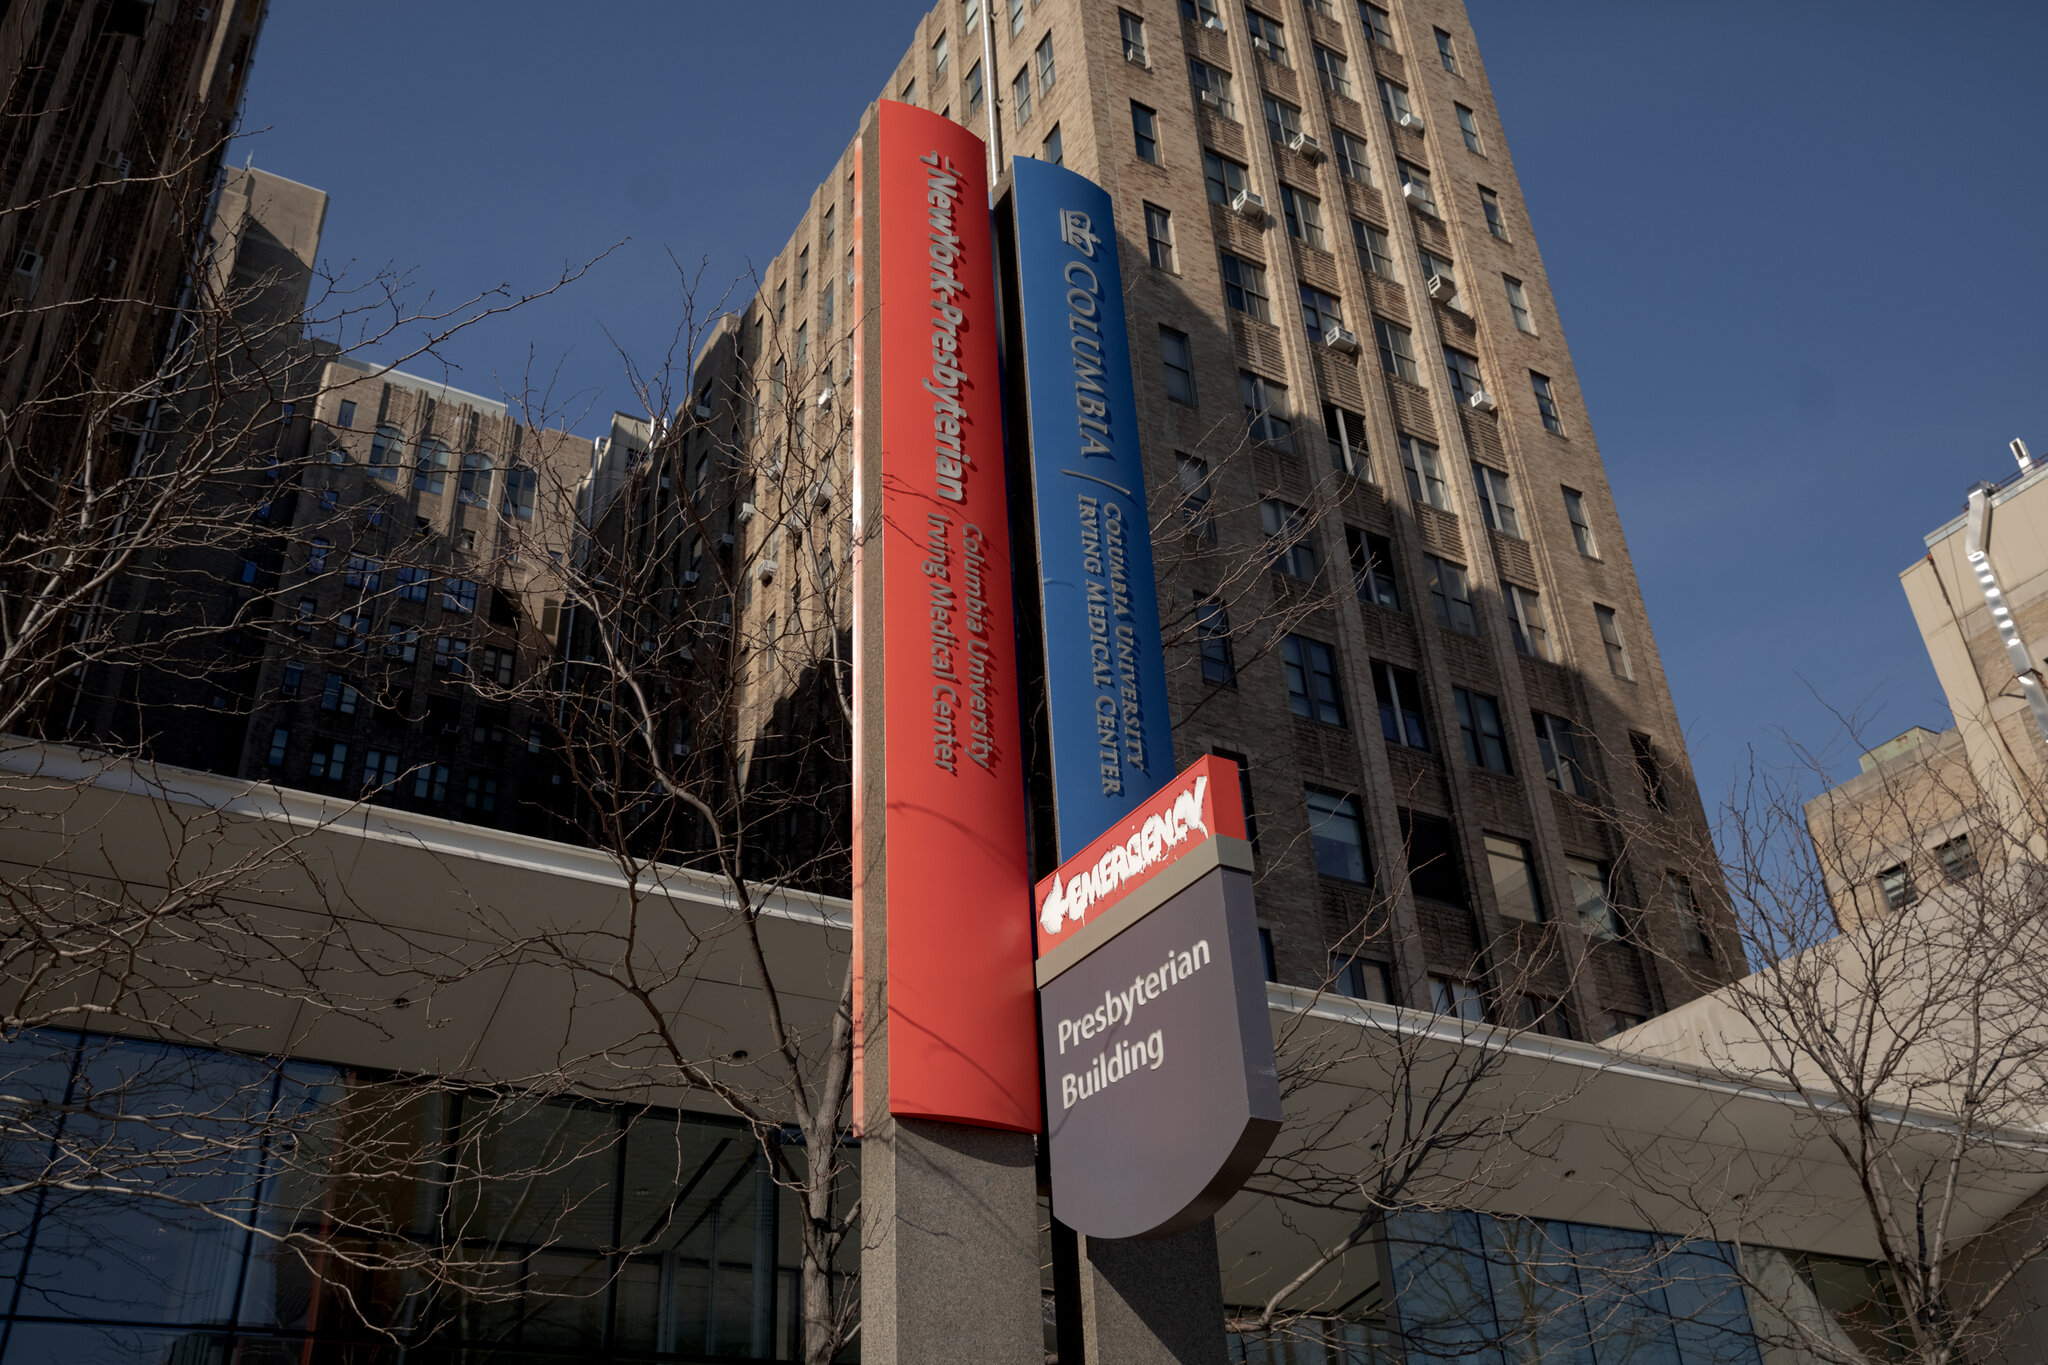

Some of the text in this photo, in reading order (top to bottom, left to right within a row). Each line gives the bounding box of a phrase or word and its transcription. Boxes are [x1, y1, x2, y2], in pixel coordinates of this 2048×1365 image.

[1064, 261, 1109, 457] COLUMBIA
[921, 512, 957, 773] Irving Medical Center
[962, 523, 989, 769] Columbia University
[1078, 494, 1121, 796] IRVING MEDICAL CENTER
[1103, 502, 1145, 771] COLUMBIA UNIVERSITY
[1066, 776, 1208, 924] EMERGENCY
[1058, 940, 1210, 1055] Presbyterian
[1062, 1029, 1164, 1109] Building
